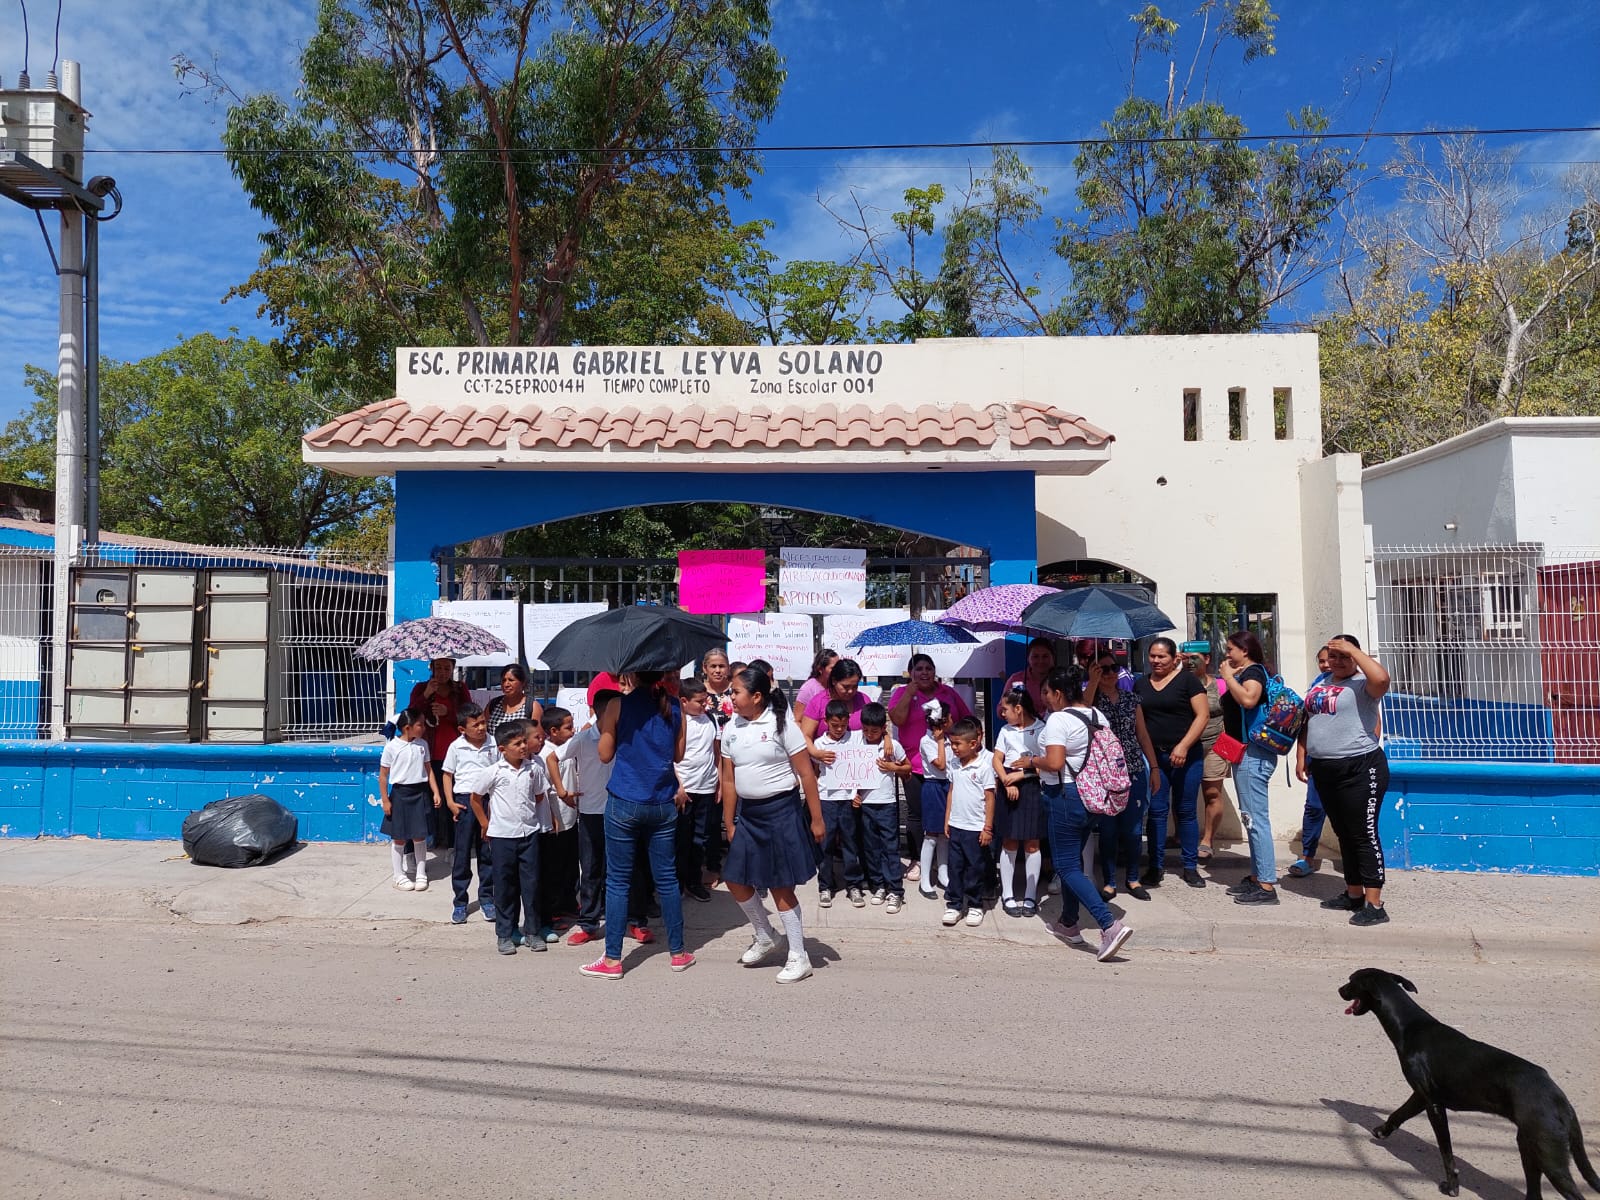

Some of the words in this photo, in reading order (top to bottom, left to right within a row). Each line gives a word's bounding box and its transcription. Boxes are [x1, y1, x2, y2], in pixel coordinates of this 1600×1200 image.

[408, 351, 450, 376] ESC.
[457, 351, 560, 375] PRIMARIA
[572, 350, 665, 376] GABRIEL
[681, 350, 762, 376] LEYVA
[778, 350, 883, 376] SOLANO
[602, 378, 645, 394] TIEMPO
[649, 378, 710, 395] COMPLETO
[750, 378, 782, 394] Zona
[788, 378, 838, 395] Escolar
[843, 377, 874, 394] 001
[782, 590, 842, 607] APOYENOS
[834, 762, 876, 780] CALOR
